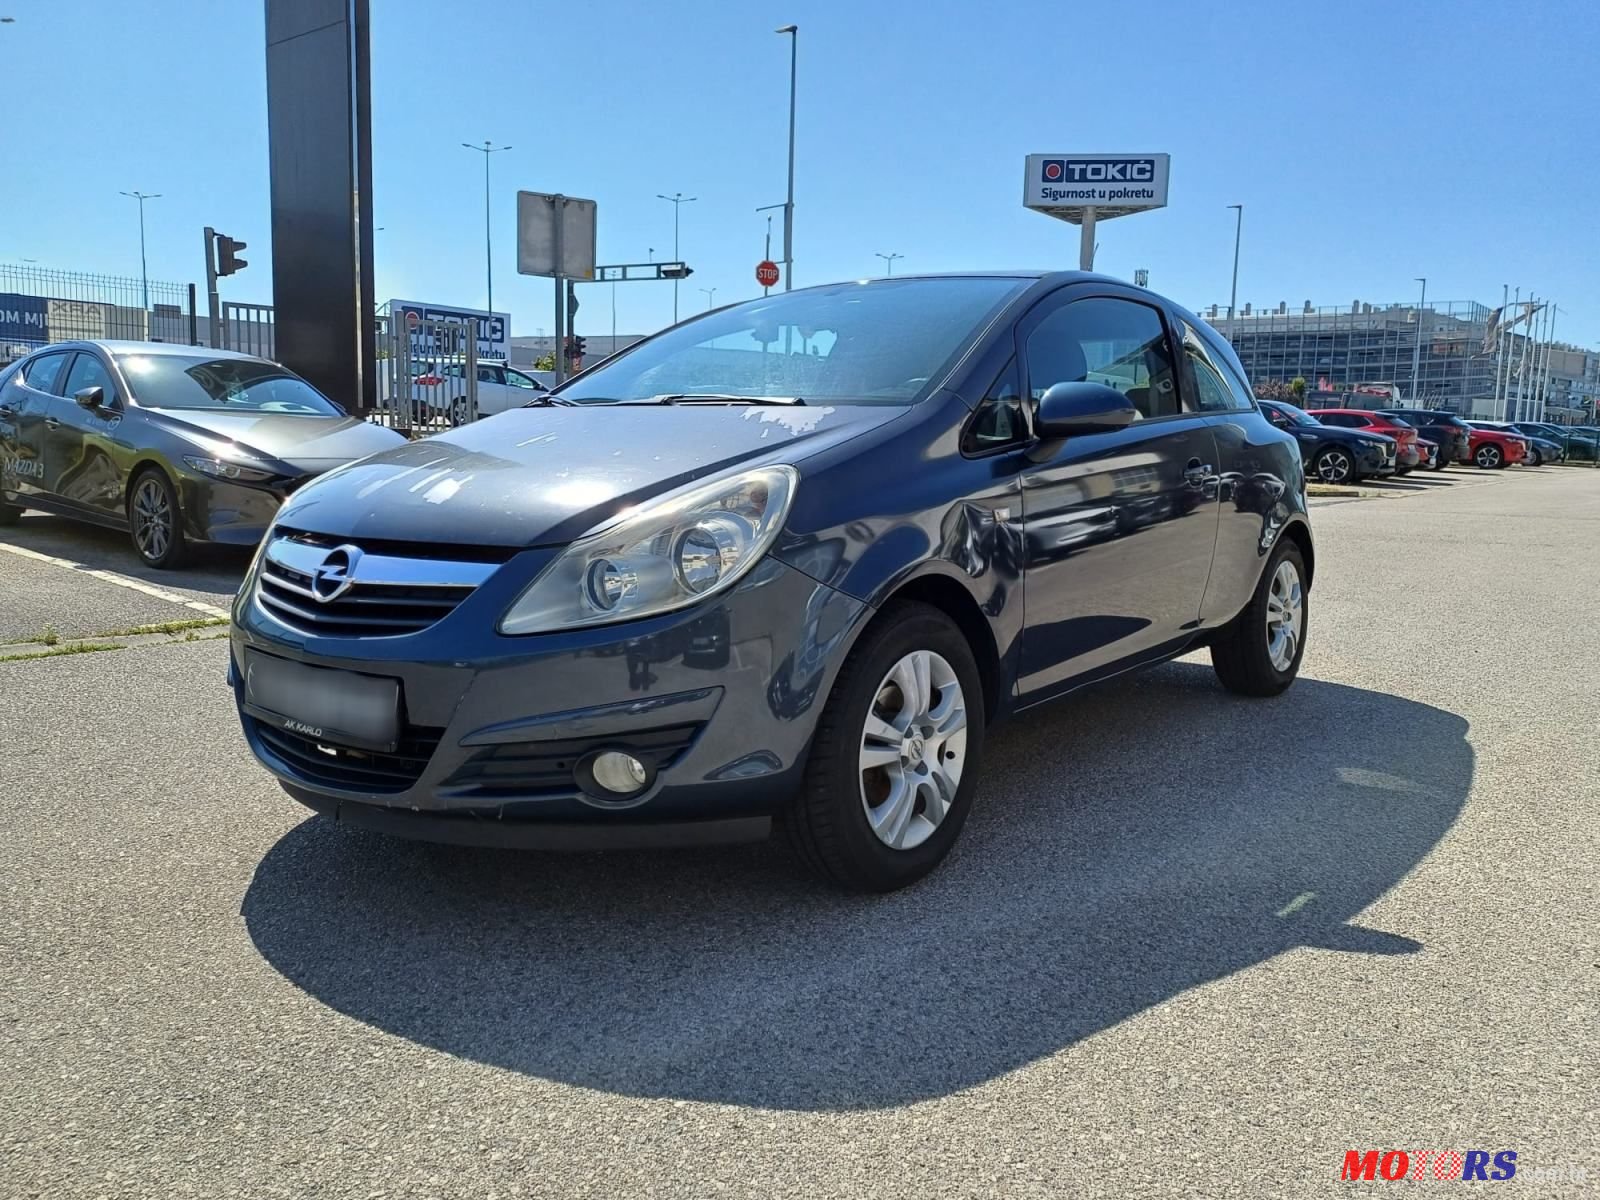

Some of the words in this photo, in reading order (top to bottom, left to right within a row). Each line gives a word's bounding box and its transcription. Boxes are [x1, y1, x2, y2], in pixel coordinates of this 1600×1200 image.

[1068, 160, 1152, 180] TOKIĆ
[1041, 187, 1096, 201] Sigurnost
[1099, 190, 1106, 198] u
[1108, 187, 1154, 201] pokretu
[758, 268, 778, 280] STOP
[283, 719, 295, 730] AK
[296, 722, 322, 737] KARLO
